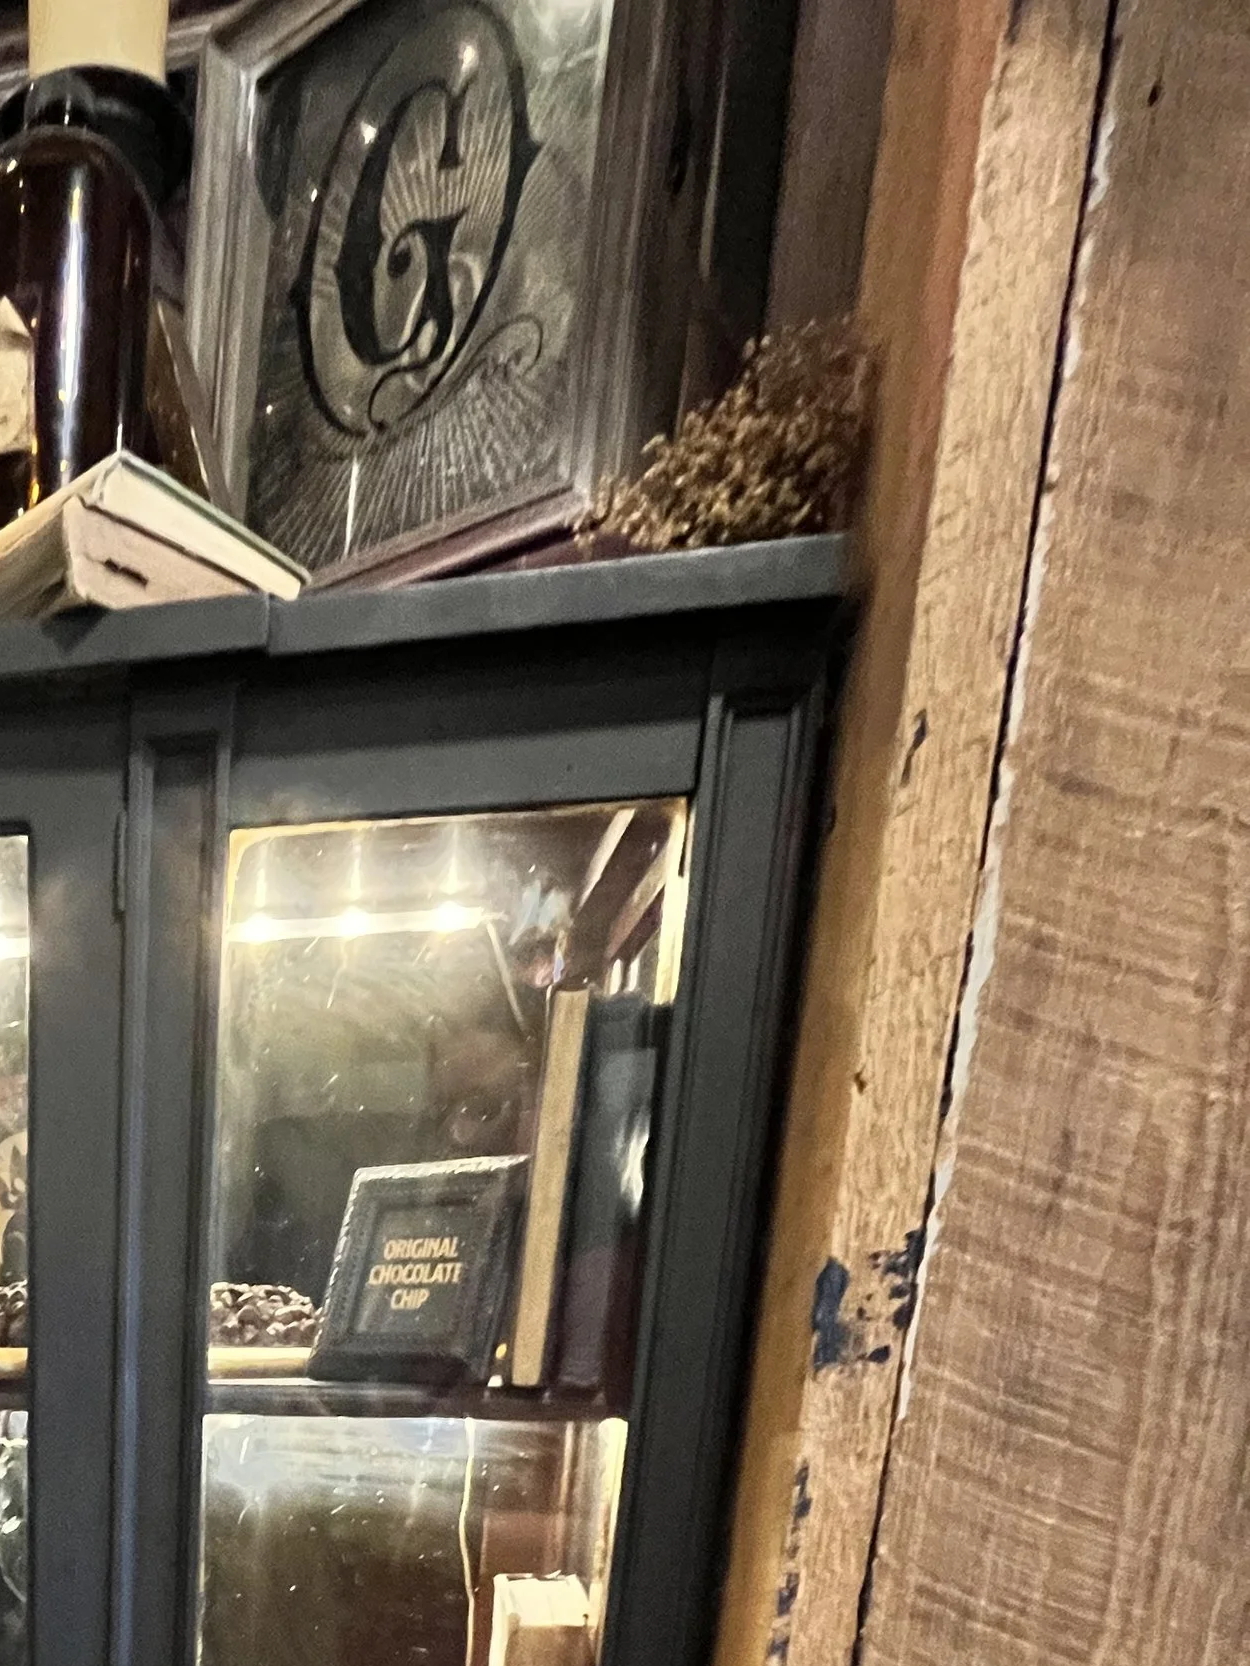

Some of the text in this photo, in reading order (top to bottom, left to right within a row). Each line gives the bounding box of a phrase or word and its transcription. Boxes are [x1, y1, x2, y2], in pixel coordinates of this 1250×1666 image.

[383, 1236, 459, 1261] ORIGINAL
[369, 1262, 463, 1286] CHOCOLATE
[391, 1288, 430, 1311] CHIP
